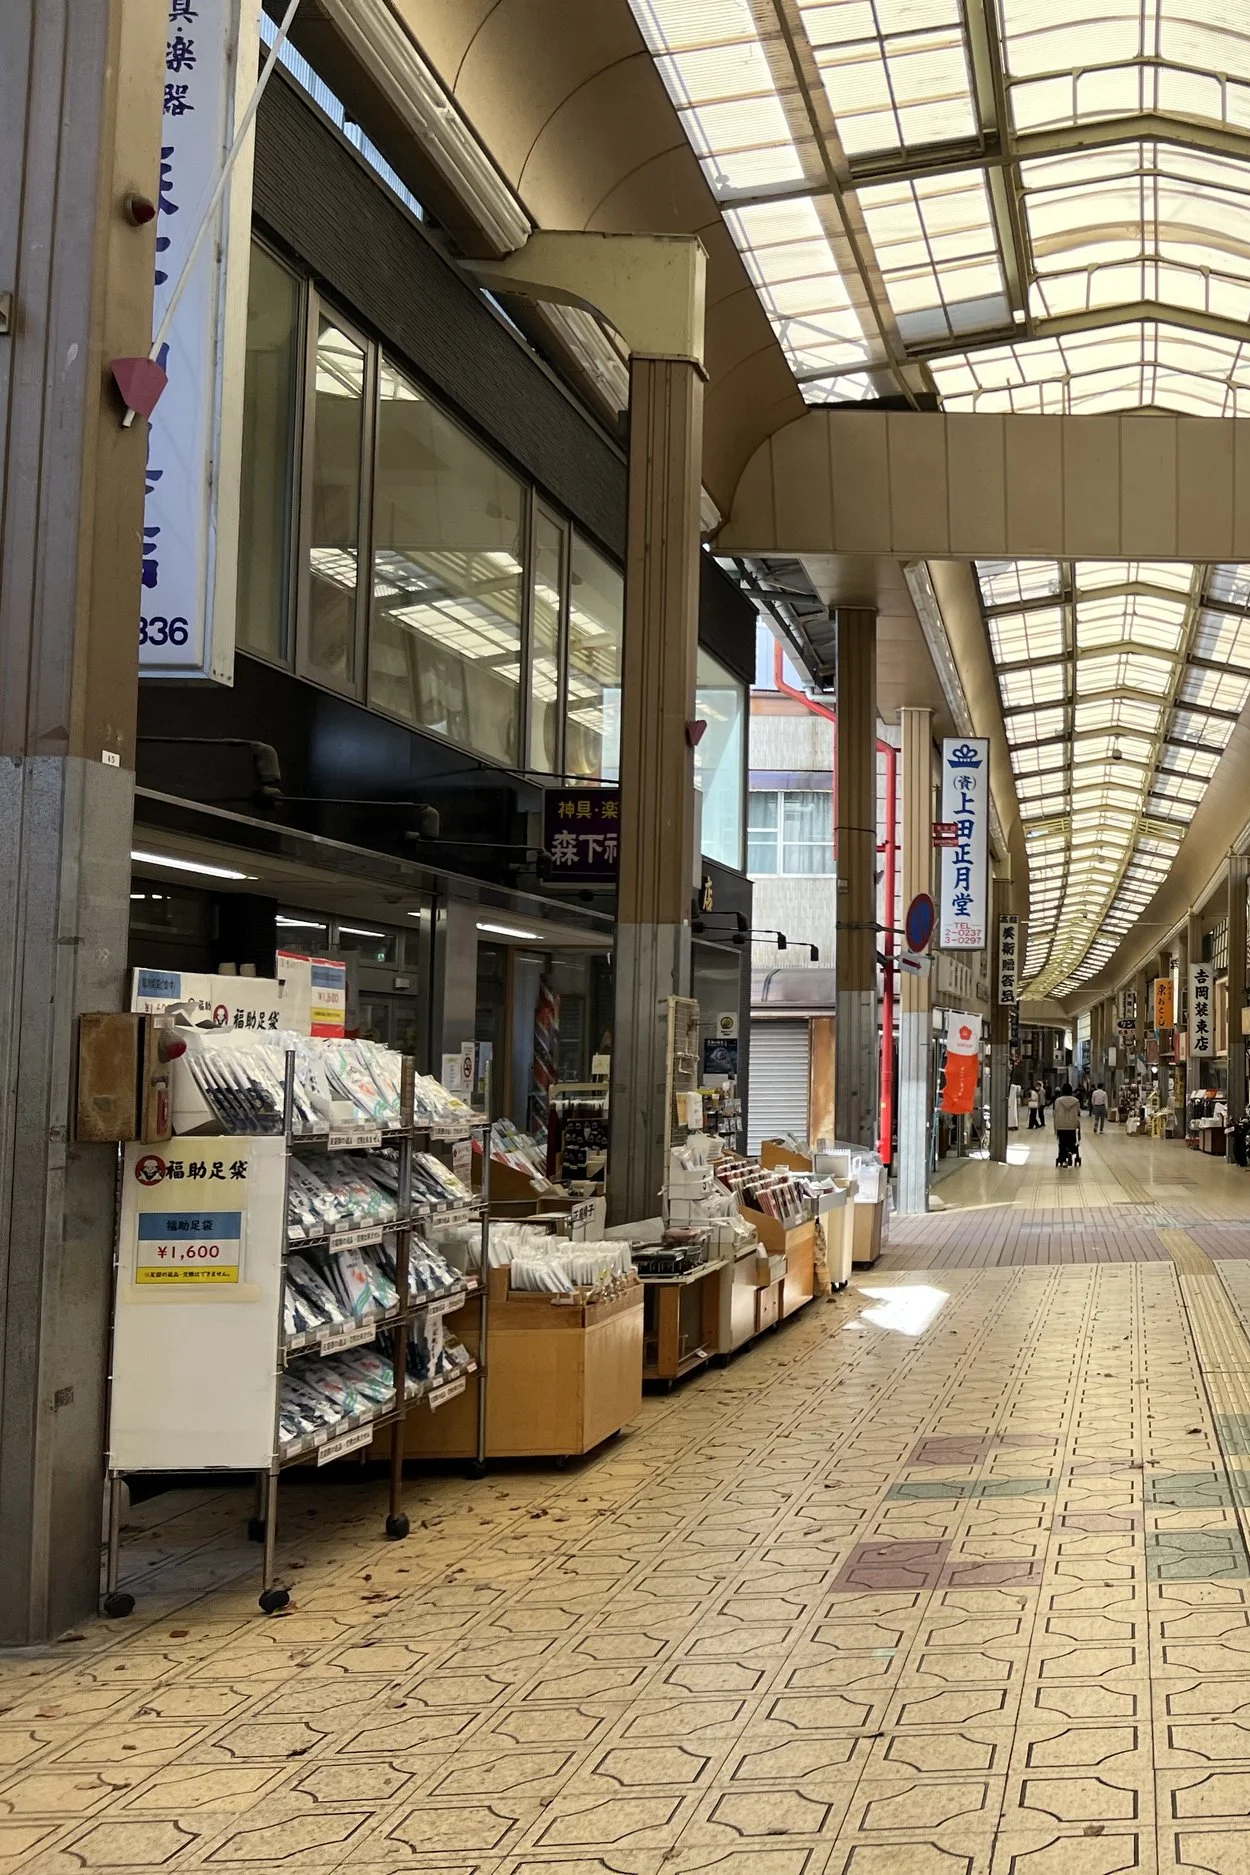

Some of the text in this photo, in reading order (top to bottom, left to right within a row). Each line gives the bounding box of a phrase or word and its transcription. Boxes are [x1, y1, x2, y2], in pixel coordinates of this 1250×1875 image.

[955, 922, 971, 930] TEL
[233, 1009, 279, 1030] 福助足袋
[166, 1160, 248, 1180] 福助足袋
[166, 1220, 214, 1231] 福助足袋
[157, 1245, 220, 1260] ¥1,600
